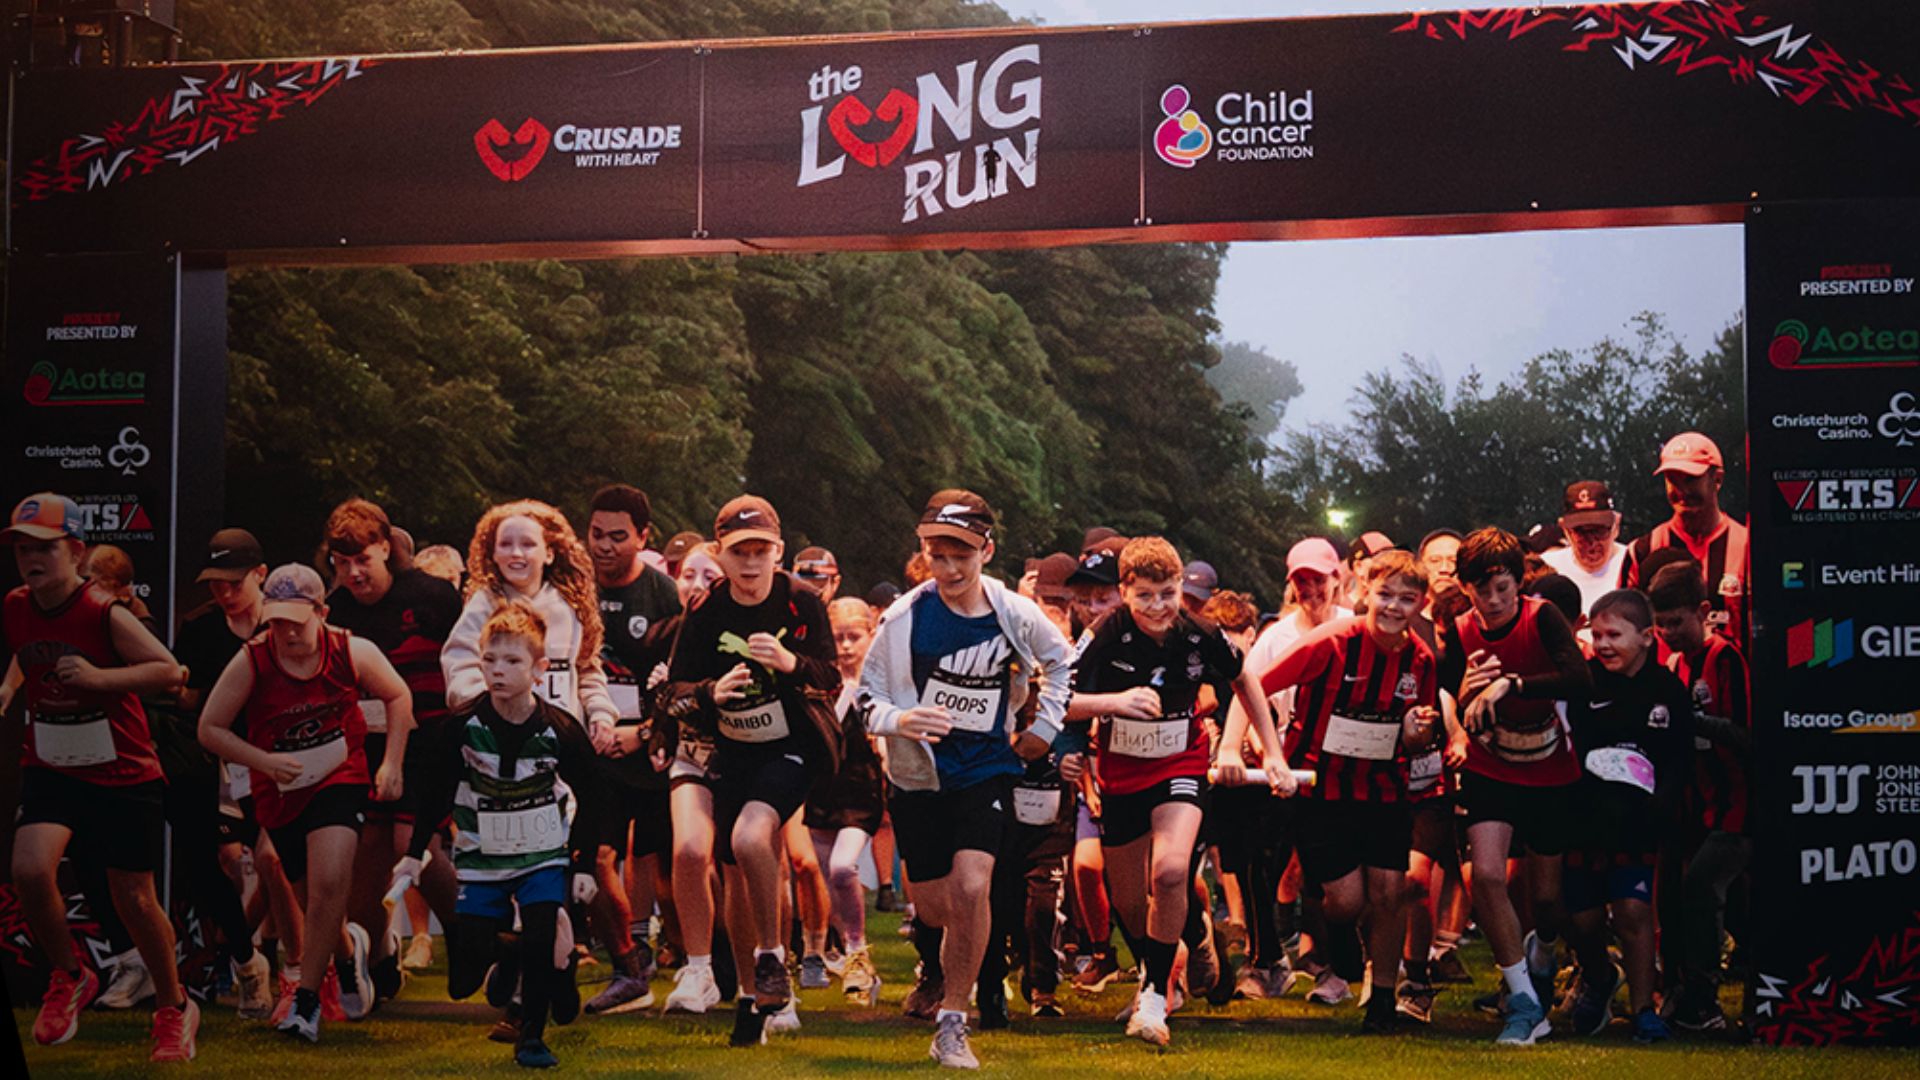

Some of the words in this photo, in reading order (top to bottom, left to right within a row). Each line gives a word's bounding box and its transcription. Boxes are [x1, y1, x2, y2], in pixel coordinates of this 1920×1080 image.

[809, 63, 862, 103] the
[1215, 89, 1314, 125] Child
[553, 123, 682, 153] CRUSADE
[1215, 120, 1314, 147] cancer
[574, 153, 610, 169] WITH
[612, 151, 659, 168] HEART
[1216, 144, 1314, 161] FOUNDATION
[902, 129, 1040, 224] RUN
[1800, 278, 1891, 296] PRESENTED
[1893, 278, 1914, 293] BY
[46, 326, 119, 341] PRESENTED
[120, 324, 138, 339] BY
[1811, 325, 1919, 351] Aotea
[59, 367, 145, 390] Aotea
[1771, 413, 1869, 429] Christchurch
[25, 444, 102, 458] Christchurch
[1821, 564, 1886, 585] Event
[934, 690, 988, 714] COOPS
[1783, 709, 1844, 728] Isaac
[1848, 709, 1916, 731] Group
[1112, 721, 1185, 752] Hunter
[1801, 838, 1917, 884] PLATO
